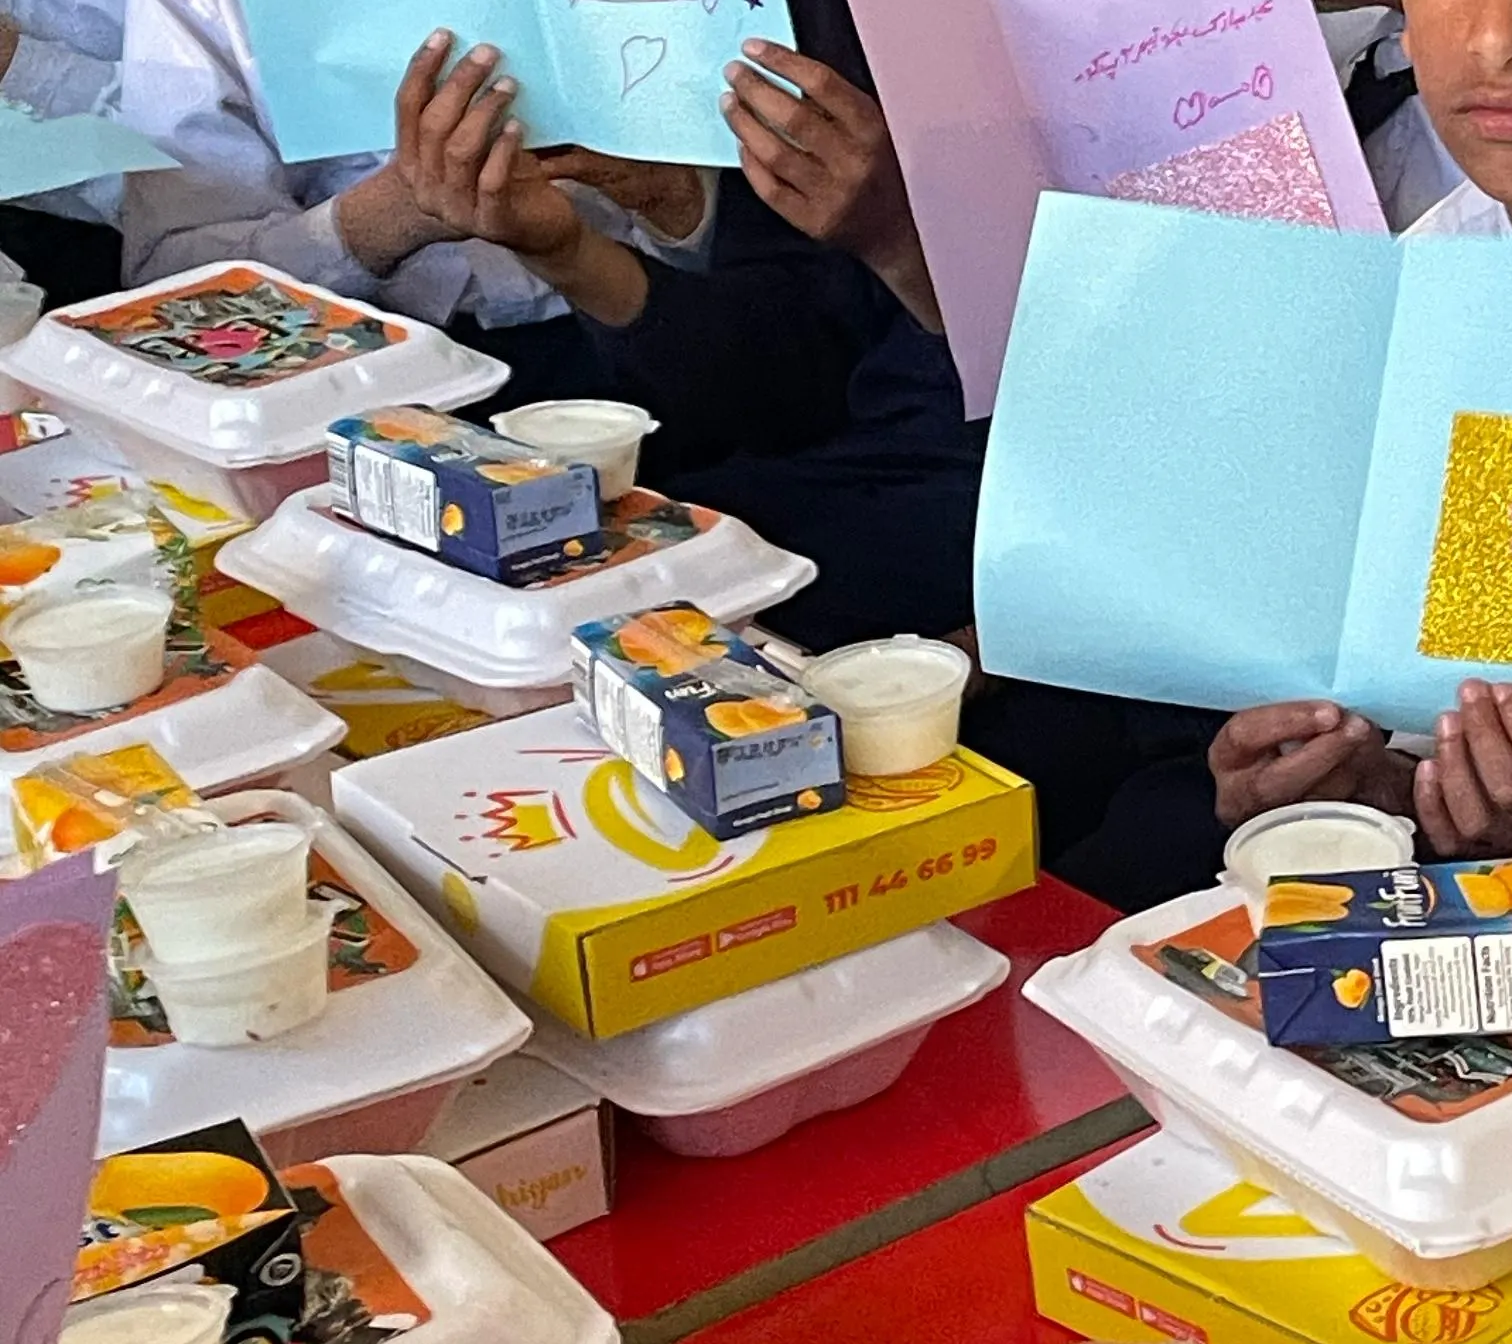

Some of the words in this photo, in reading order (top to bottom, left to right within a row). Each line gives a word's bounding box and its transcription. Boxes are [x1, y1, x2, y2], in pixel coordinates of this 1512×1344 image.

[824, 883, 859, 914] 111
[869, 869, 908, 897] 44
[917, 853, 954, 882] 66
[962, 838, 998, 866] 99
